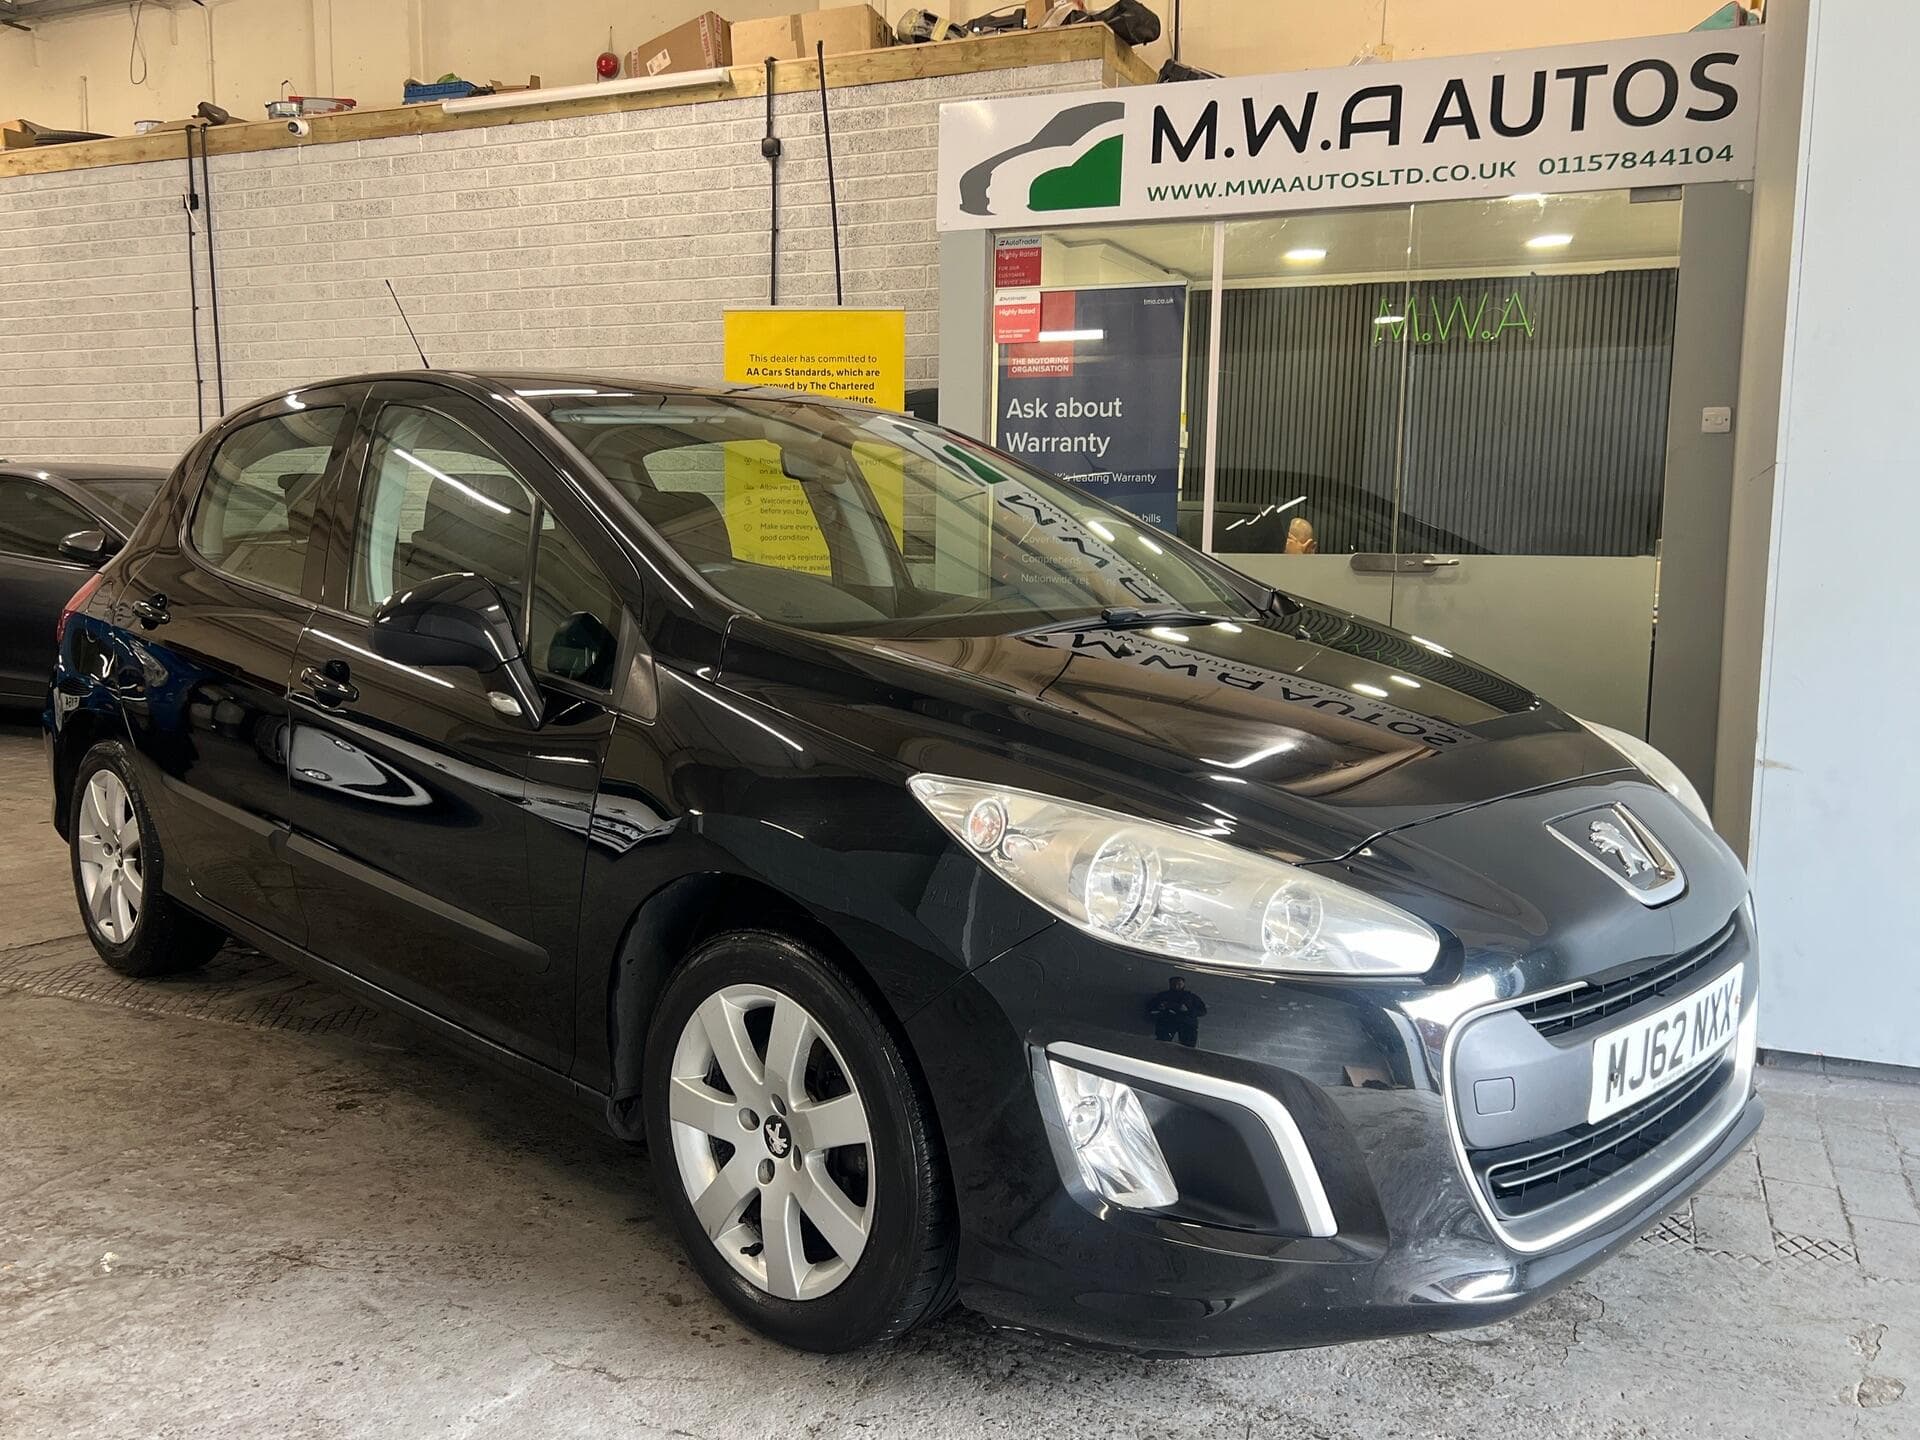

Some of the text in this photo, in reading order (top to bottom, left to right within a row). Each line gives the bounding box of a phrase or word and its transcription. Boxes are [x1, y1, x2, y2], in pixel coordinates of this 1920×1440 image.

[1151, 52, 1740, 164] M.W.A AUTOS
[1147, 144, 1734, 201] WWW.MWAAUTOSLTD.CO.UK 01157844104
[749, 354, 878, 363] This dealer has committed to
[1012, 356, 1069, 366] THE MOTORING
[746, 368, 760, 376] AA
[761, 368, 783, 376] Cars
[785, 368, 835, 377] Standards,
[836, 368, 864, 376] which
[1011, 365, 1069, 373] ORGANISATION
[797, 382, 807, 391] by
[810, 382, 827, 390] The
[828, 382, 875, 390] Chartered
[1006, 397, 1122, 419] Ask about
[1006, 432, 1111, 458] Warranty
[1113, 472, 1157, 485] Warranty
[759, 483, 778, 491] Allow
[760, 497, 791, 505] Welcome
[796, 508, 808, 516] buy
[760, 534, 777, 542] good
[760, 553, 786, 561] Provide
[1605, 977, 1735, 1104] MJ62 NXX
